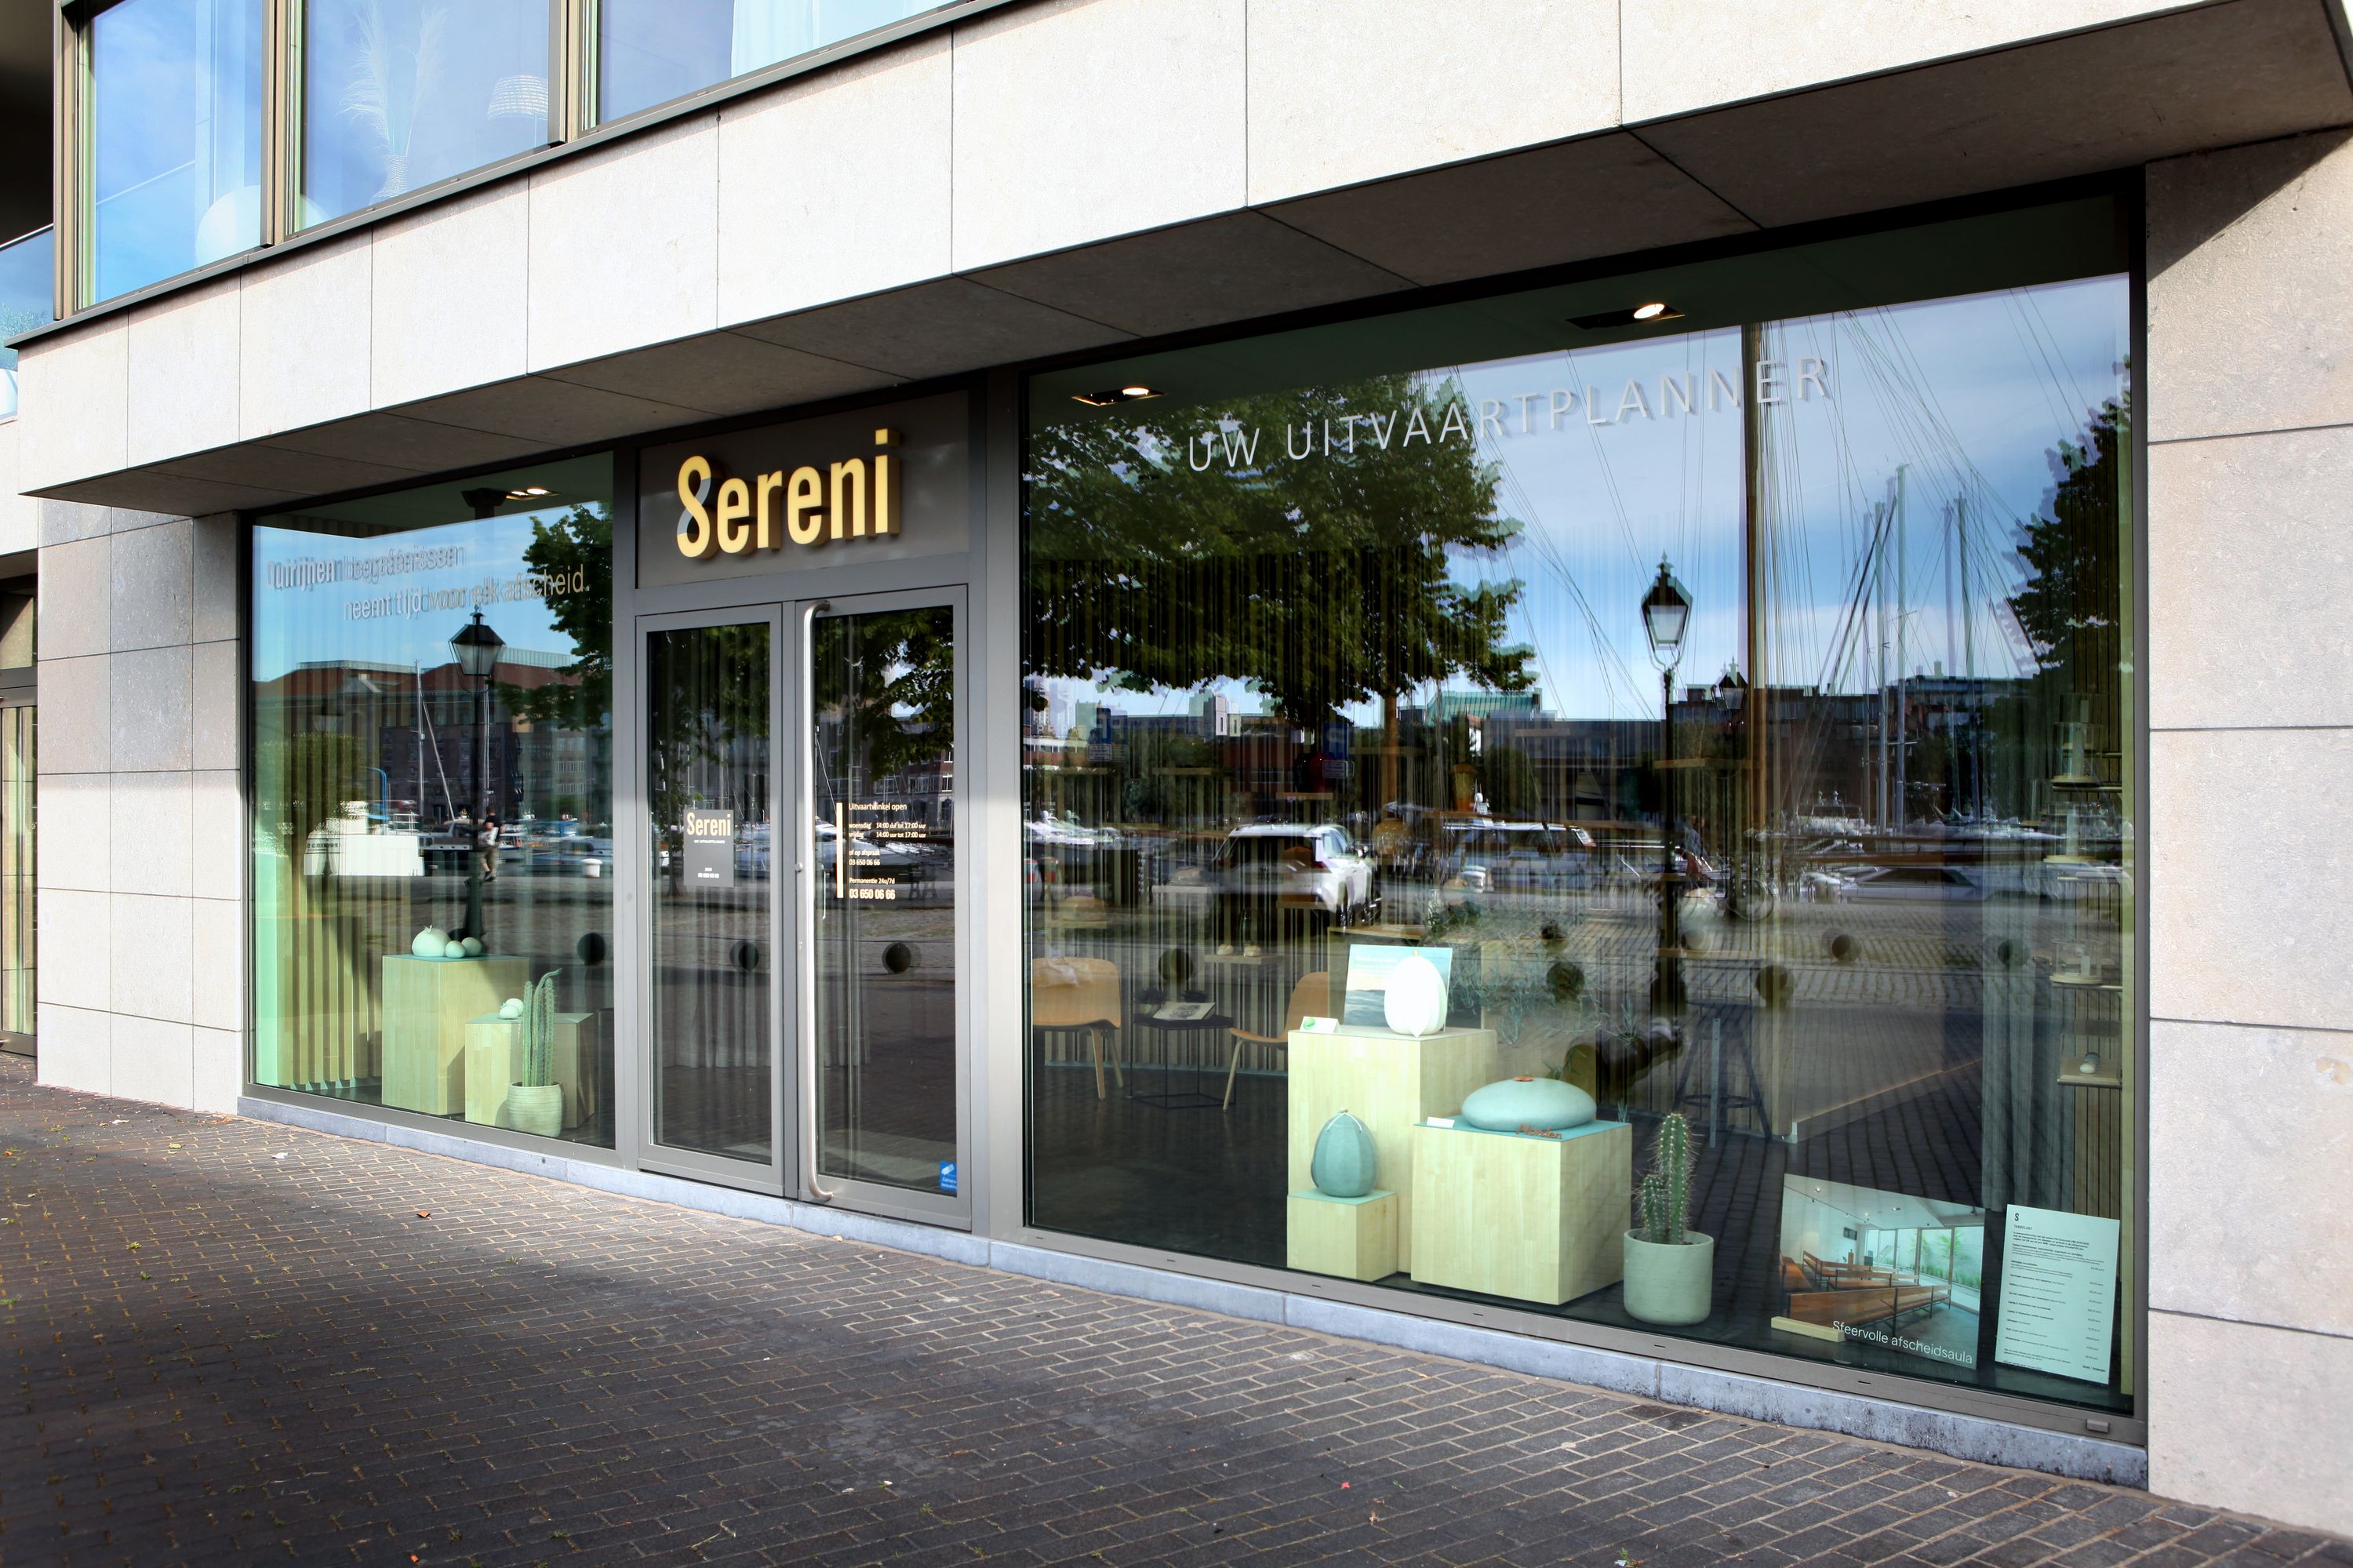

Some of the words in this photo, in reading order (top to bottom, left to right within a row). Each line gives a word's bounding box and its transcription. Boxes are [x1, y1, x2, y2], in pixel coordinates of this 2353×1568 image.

[1189, 427, 1260, 471] UW
[1287, 357, 1826, 460] UITVAARTPLANNER
[677, 428, 889, 558] Sereni
[266, 555, 337, 591] Quirijnen
[344, 595, 391, 620] neemt
[395, 588, 424, 620] tijd
[428, 587, 467, 611] voor
[471, 577, 500, 606] elk
[504, 563, 591, 602] afscheid.
[686, 812, 731, 836] Sereni
[849, 802, 891, 811] Uitvaartwinkel
[849, 889, 859, 899] 03
[860, 889, 874, 899] 650
[875, 889, 885, 900] 06
[886, 889, 896, 900] 66
[1833, 1320, 1889, 1344] Sfeervolle
[1891, 1337, 1973, 1364] afscheidsaula
